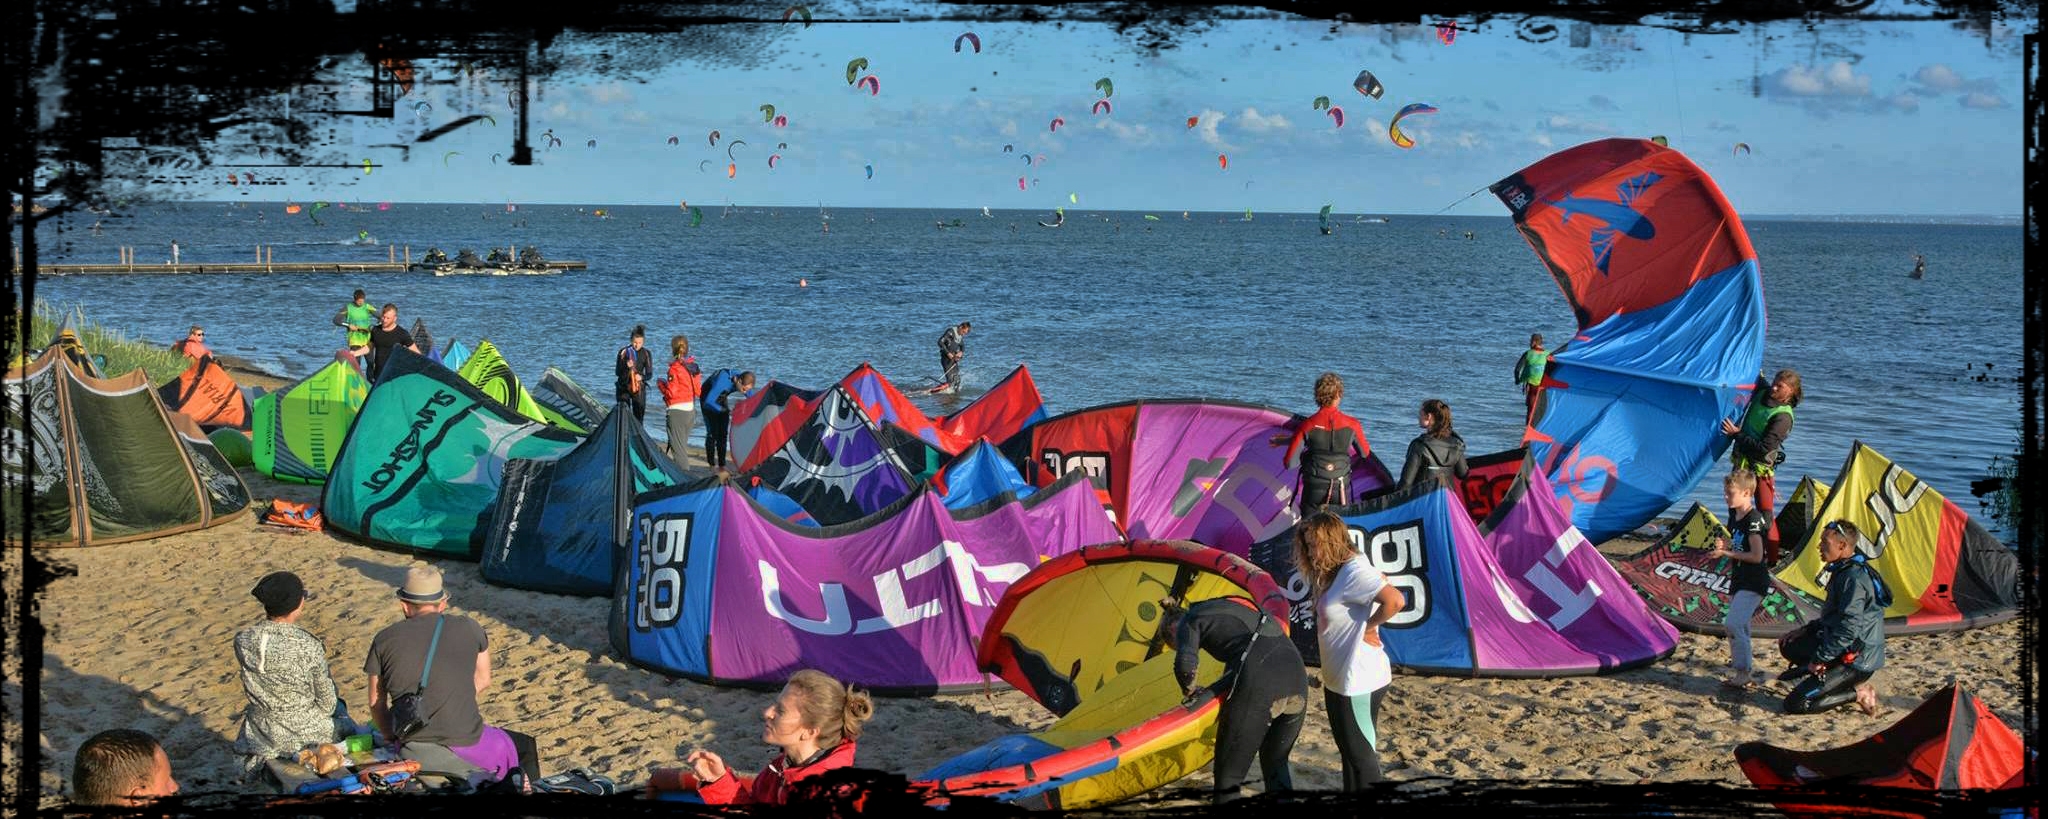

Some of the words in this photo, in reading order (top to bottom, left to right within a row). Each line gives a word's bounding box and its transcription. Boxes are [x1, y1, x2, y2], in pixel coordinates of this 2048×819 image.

[361, 389, 457, 496] SLINGSHOT
[637, 517, 652, 628] FIFTY
[649, 518, 689, 623] 50
[1371, 525, 1427, 625] 50
[1654, 560, 1732, 595] CATAL
